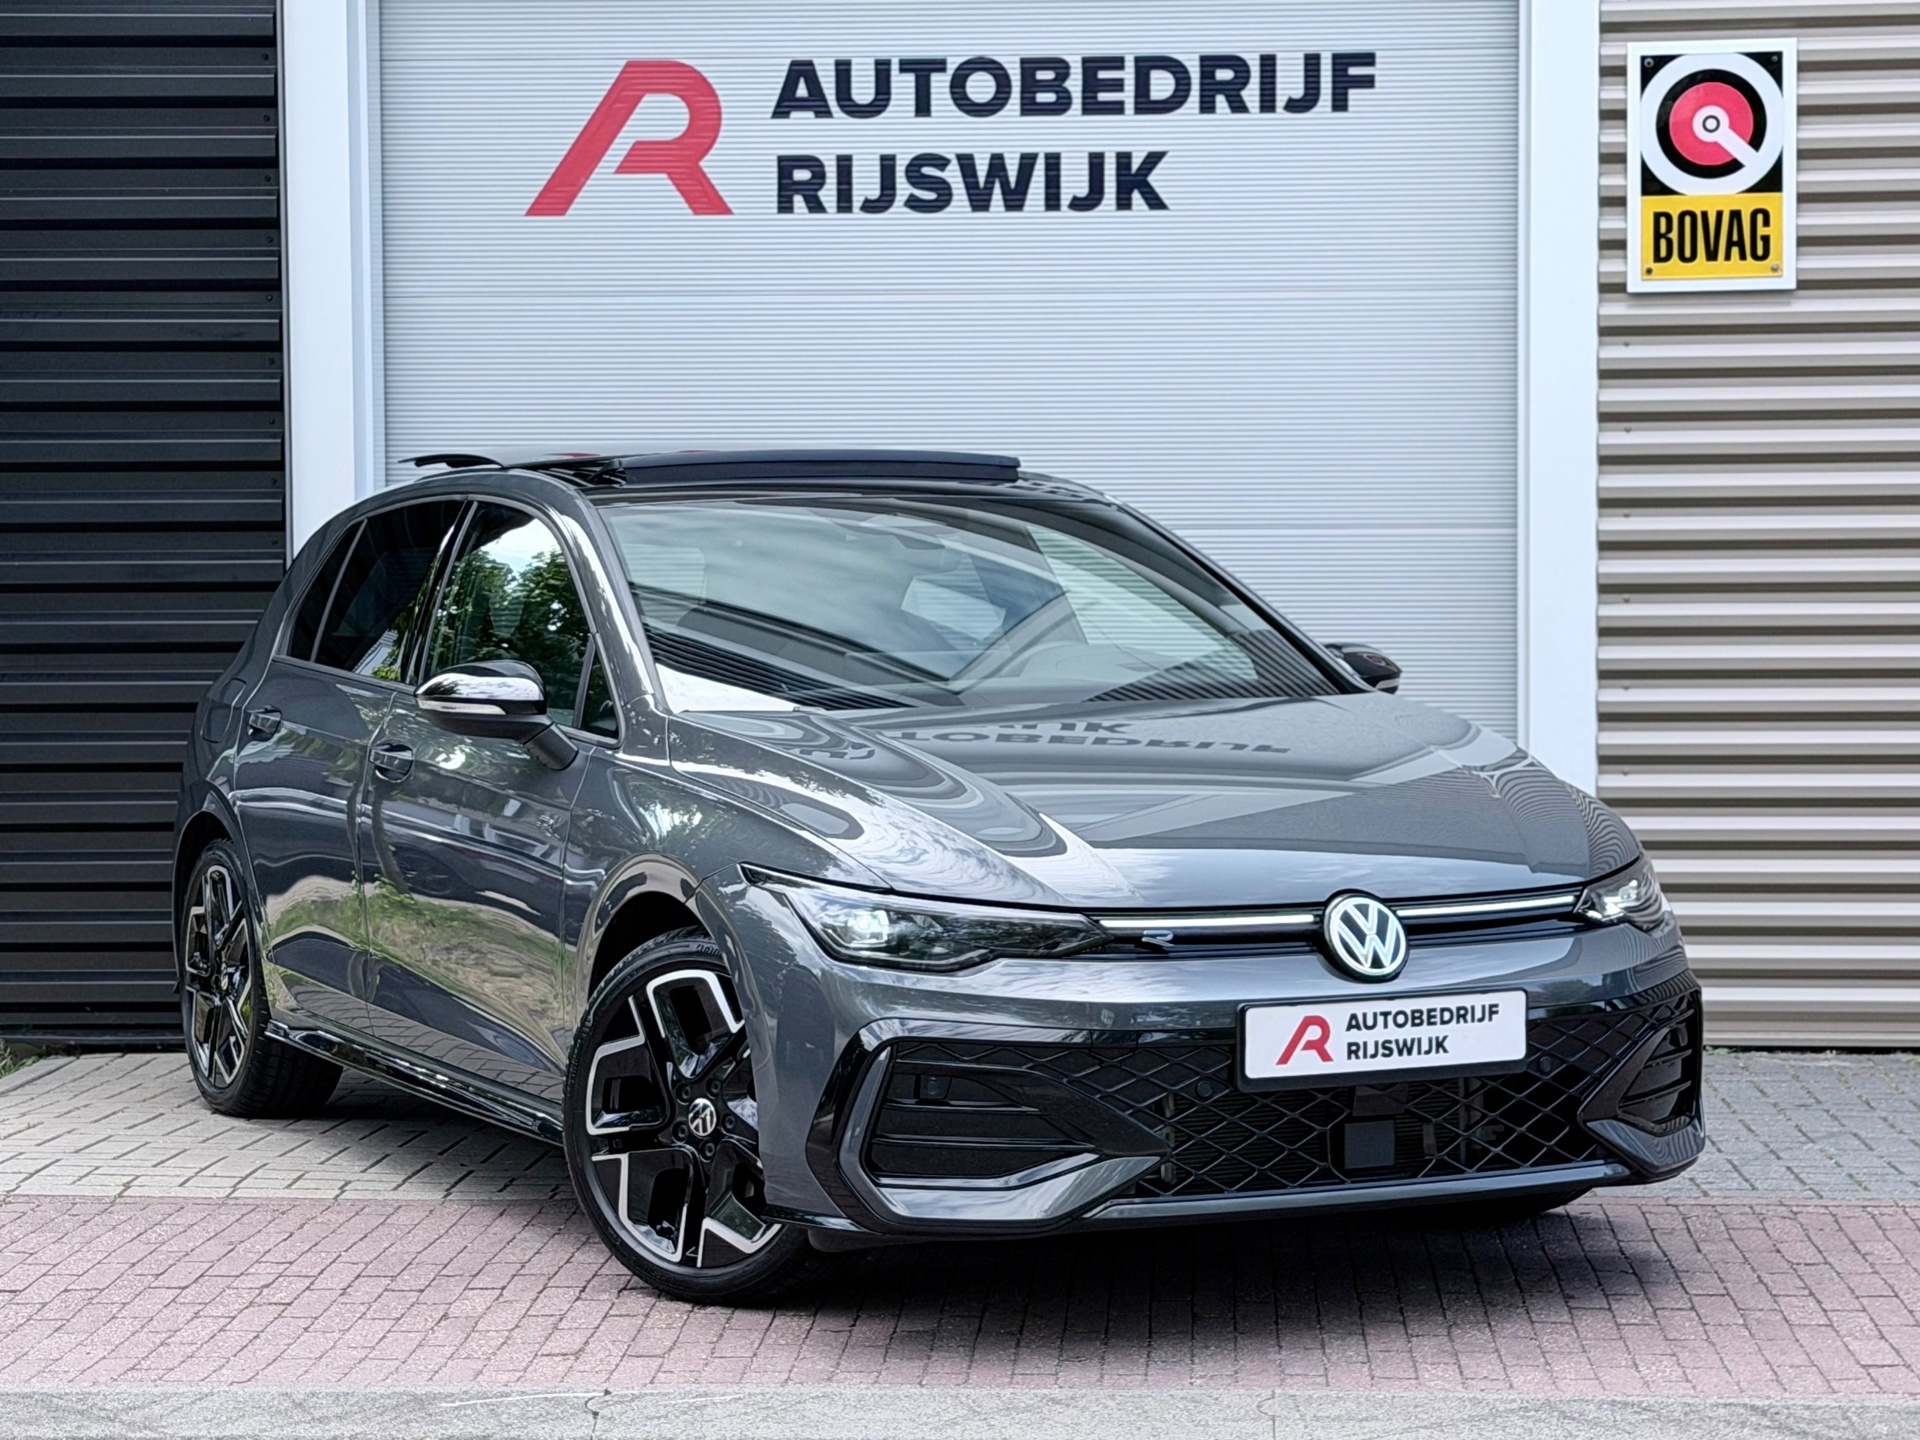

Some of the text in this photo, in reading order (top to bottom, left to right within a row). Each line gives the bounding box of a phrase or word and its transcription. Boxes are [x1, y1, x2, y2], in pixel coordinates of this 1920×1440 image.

[771, 52, 1377, 119] AUTOBEDRIJF
[775, 150, 1170, 214] RIJSWIJK
[1652, 207, 1772, 264] BOVAG
[1345, 1003, 1500, 1032] AUTOBEDRIJF
[1346, 1034, 1450, 1061] RIJSWIJK
